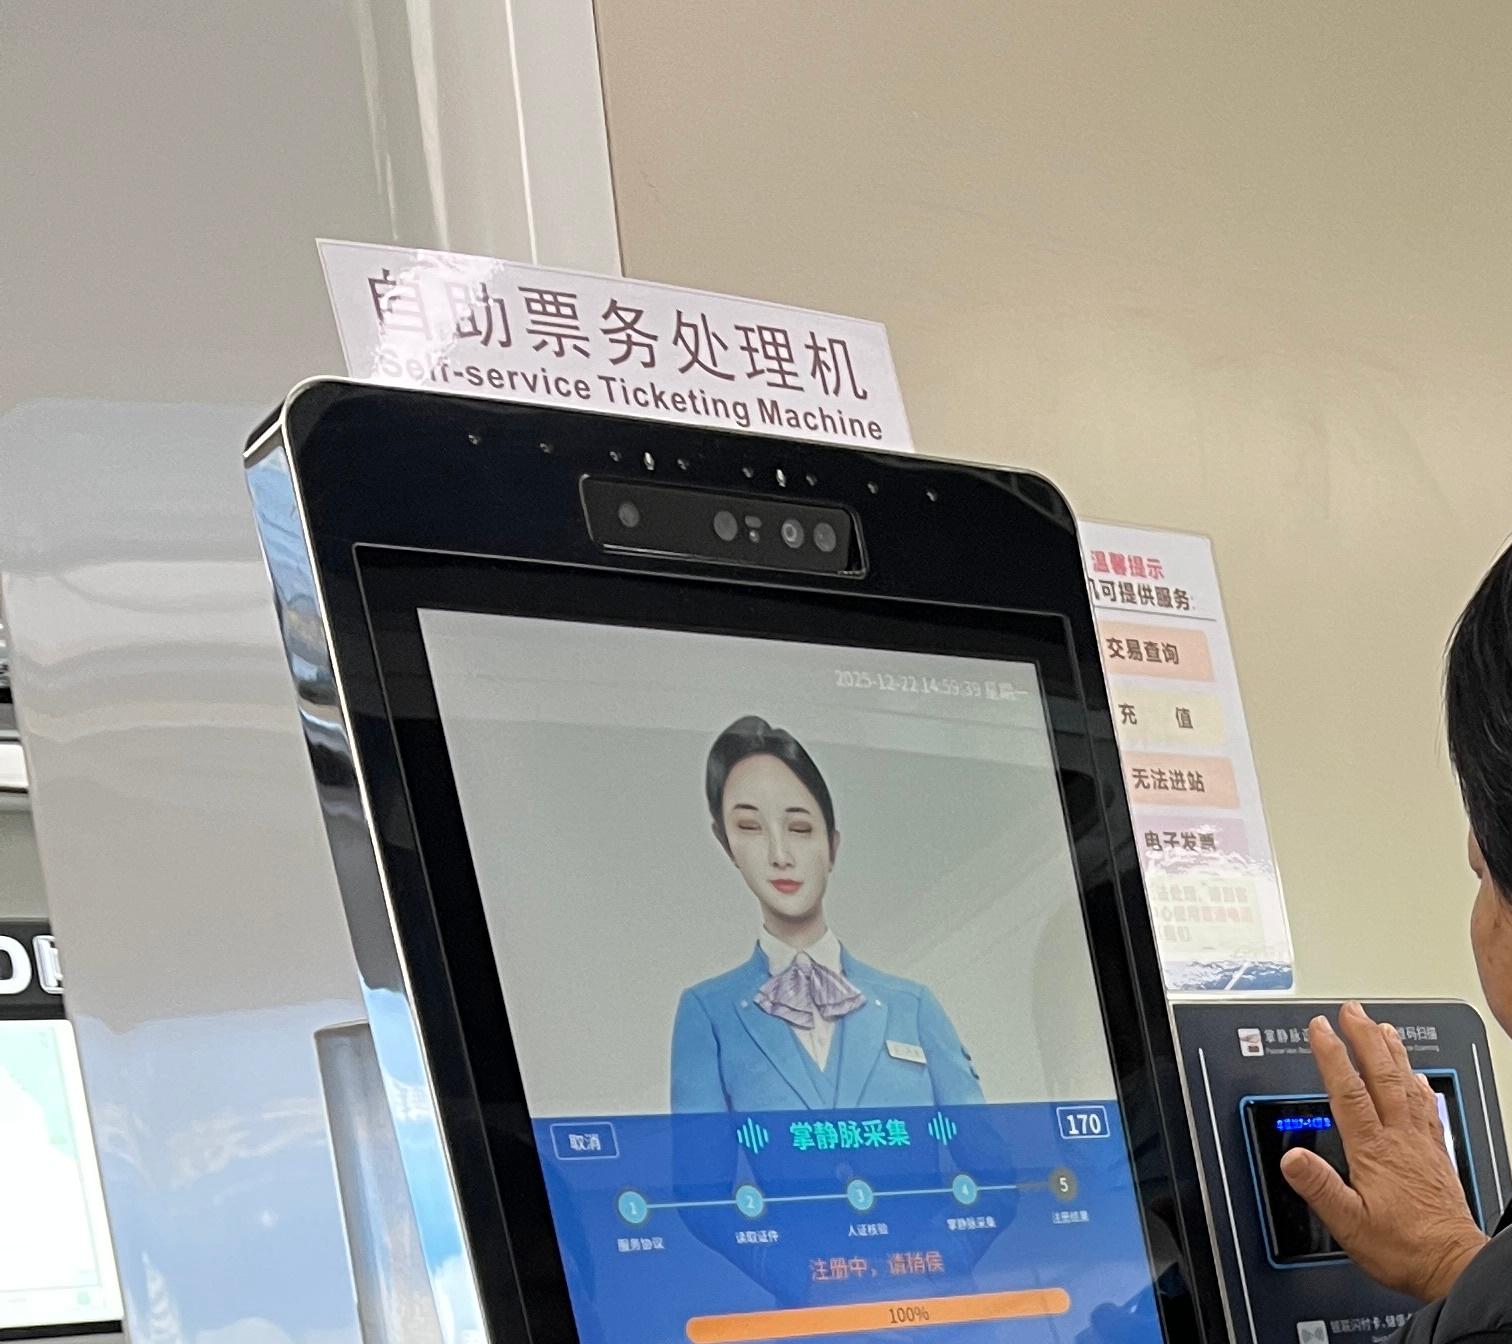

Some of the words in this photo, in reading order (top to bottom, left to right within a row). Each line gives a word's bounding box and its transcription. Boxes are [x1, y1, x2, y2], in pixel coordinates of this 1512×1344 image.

[368, 268, 868, 400] 自助票务处理机
[598, 375, 750, 428] Ticketing
[758, 398, 884, 442] Machine
[1090, 550, 1165, 580] 温馨提示
[1106, 637, 1180, 665] 交易查询
[1132, 768, 1206, 793] 无法进站
[1144, 828, 1217, 851] 电子发票
[790, 1118, 911, 1151] 掌静脉采集
[1066, 1113, 1101, 1136] 170
[569, 1133, 602, 1151] 取消
[1059, 1176, 1069, 1192] 5
[888, 1306, 930, 1324] 100%
